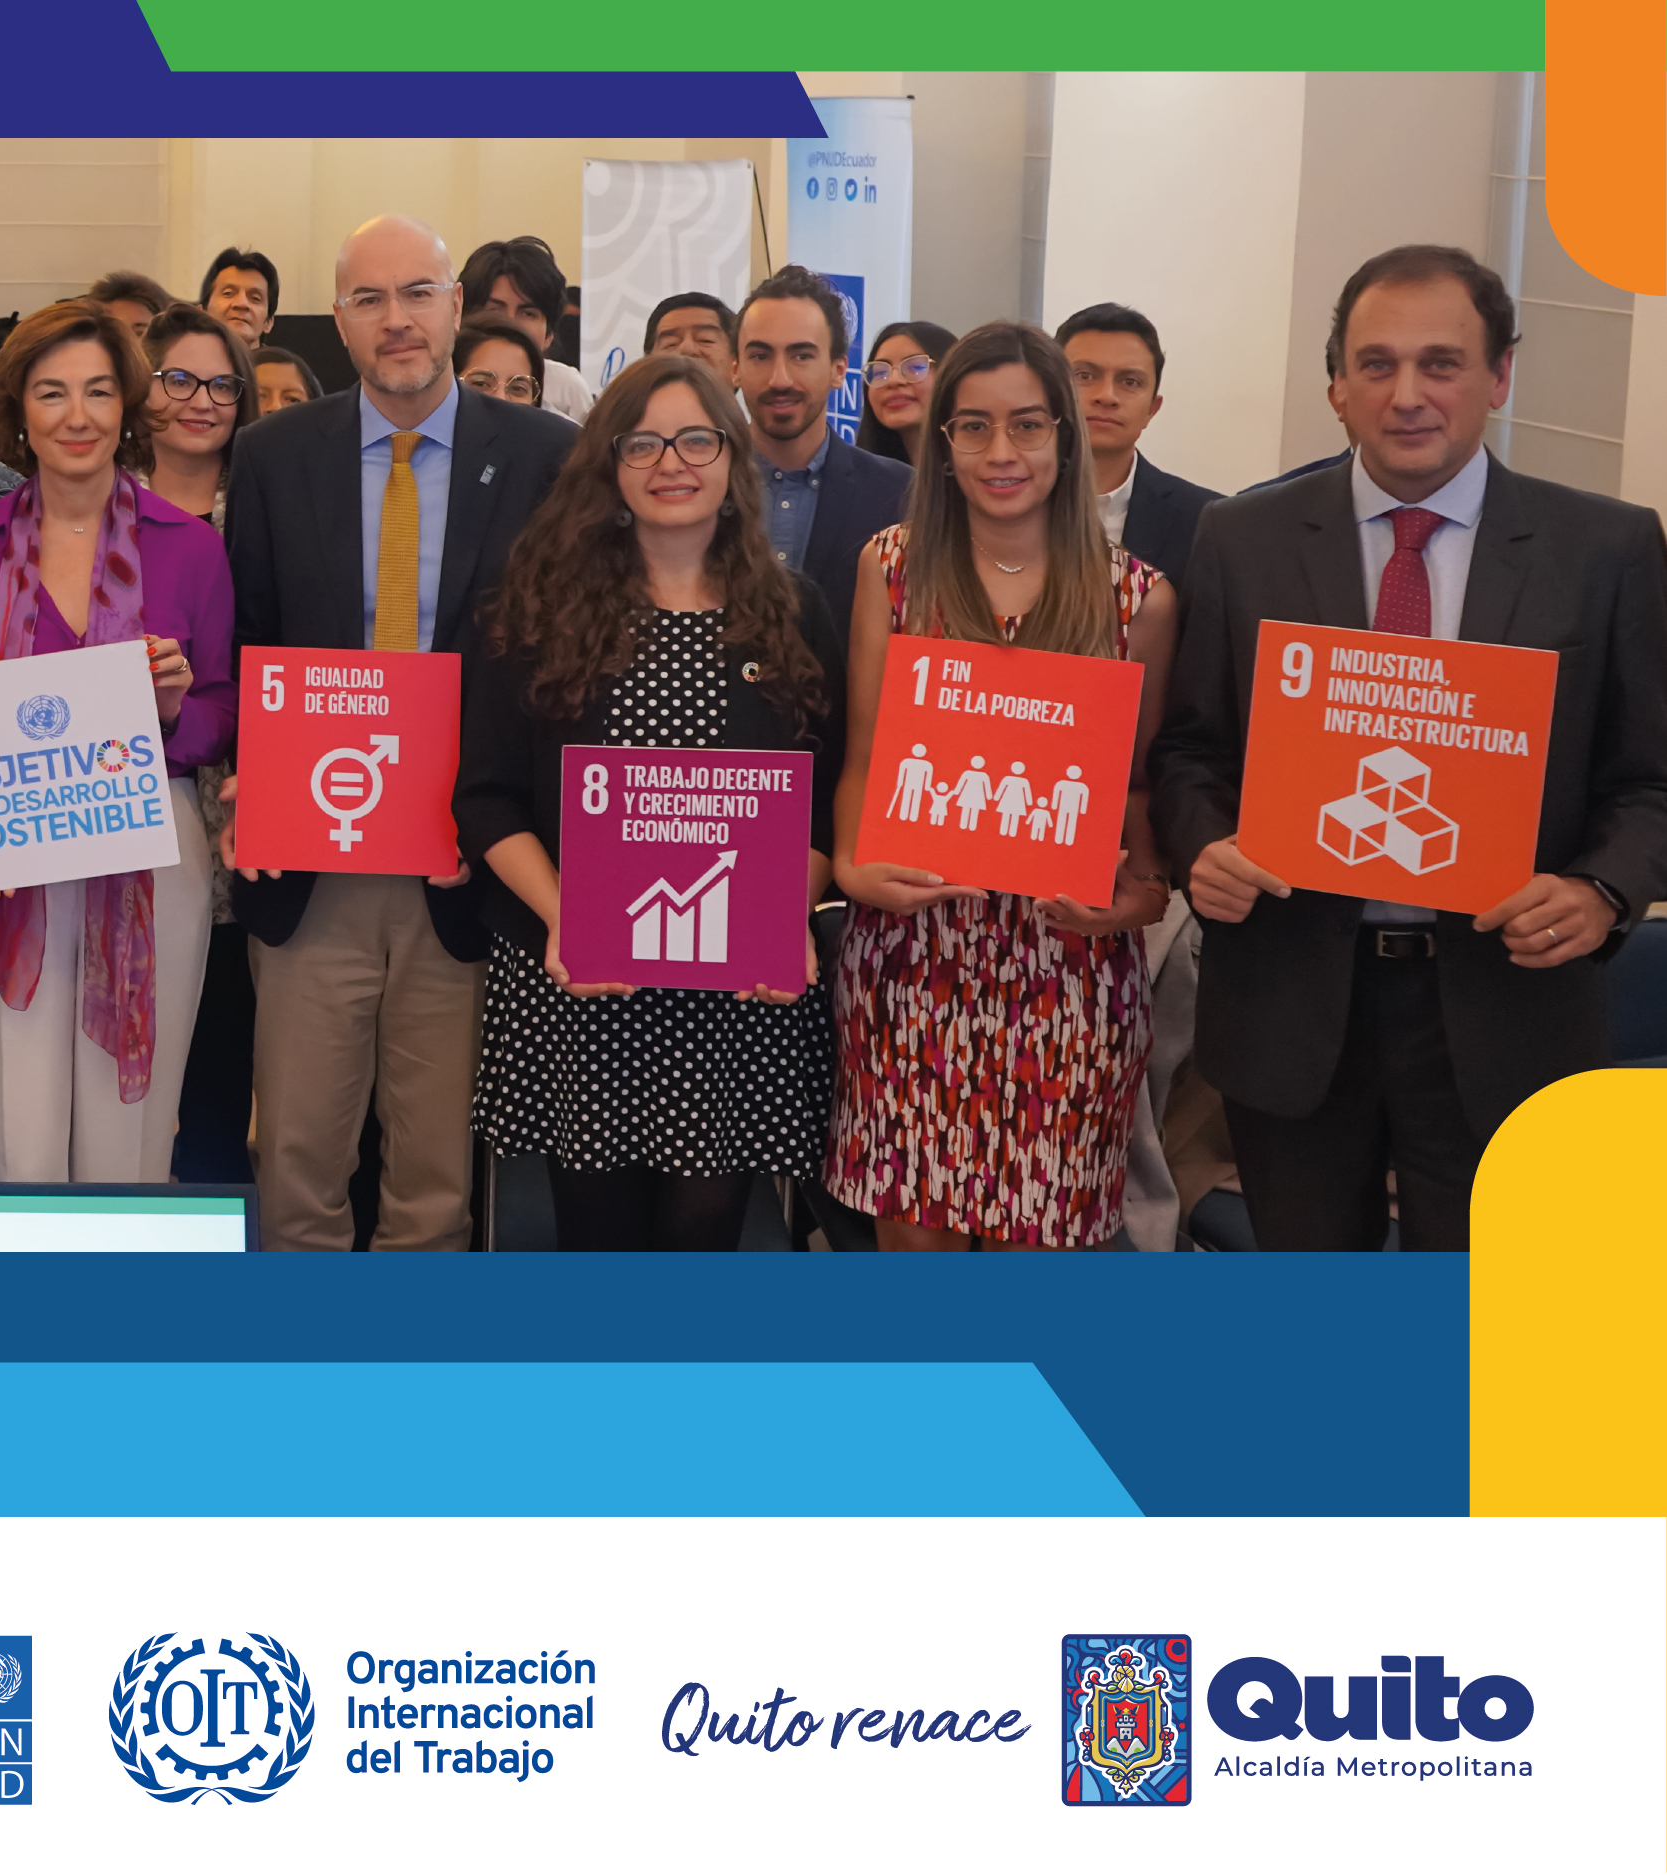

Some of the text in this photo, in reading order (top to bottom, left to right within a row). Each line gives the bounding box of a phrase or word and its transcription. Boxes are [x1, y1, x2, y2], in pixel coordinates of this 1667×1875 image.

[808, 151, 877, 168] @PNUDEcuador
[305, 666, 384, 689] IGUALDAD
[912, 656, 930, 706] 1
[942, 659, 972, 683] FIN
[1280, 641, 1314, 698] 9
[1330, 647, 1451, 686] INDUSTRIA,
[261, 664, 285, 712] 5
[304, 691, 390, 716] DE GÉNERO
[937, 687, 1075, 727] DE LA POBREZA
[1327, 677, 1477, 719] INNOVACIÓN E
[1324, 707, 1529, 757] INFRAESTRUCTURA
[582, 763, 609, 815] 8
[624, 765, 793, 792] TRABAJO DECENTE
[623, 792, 759, 818] Y CRECIMIENTO
[622, 817, 730, 845] ECONÓMICO
